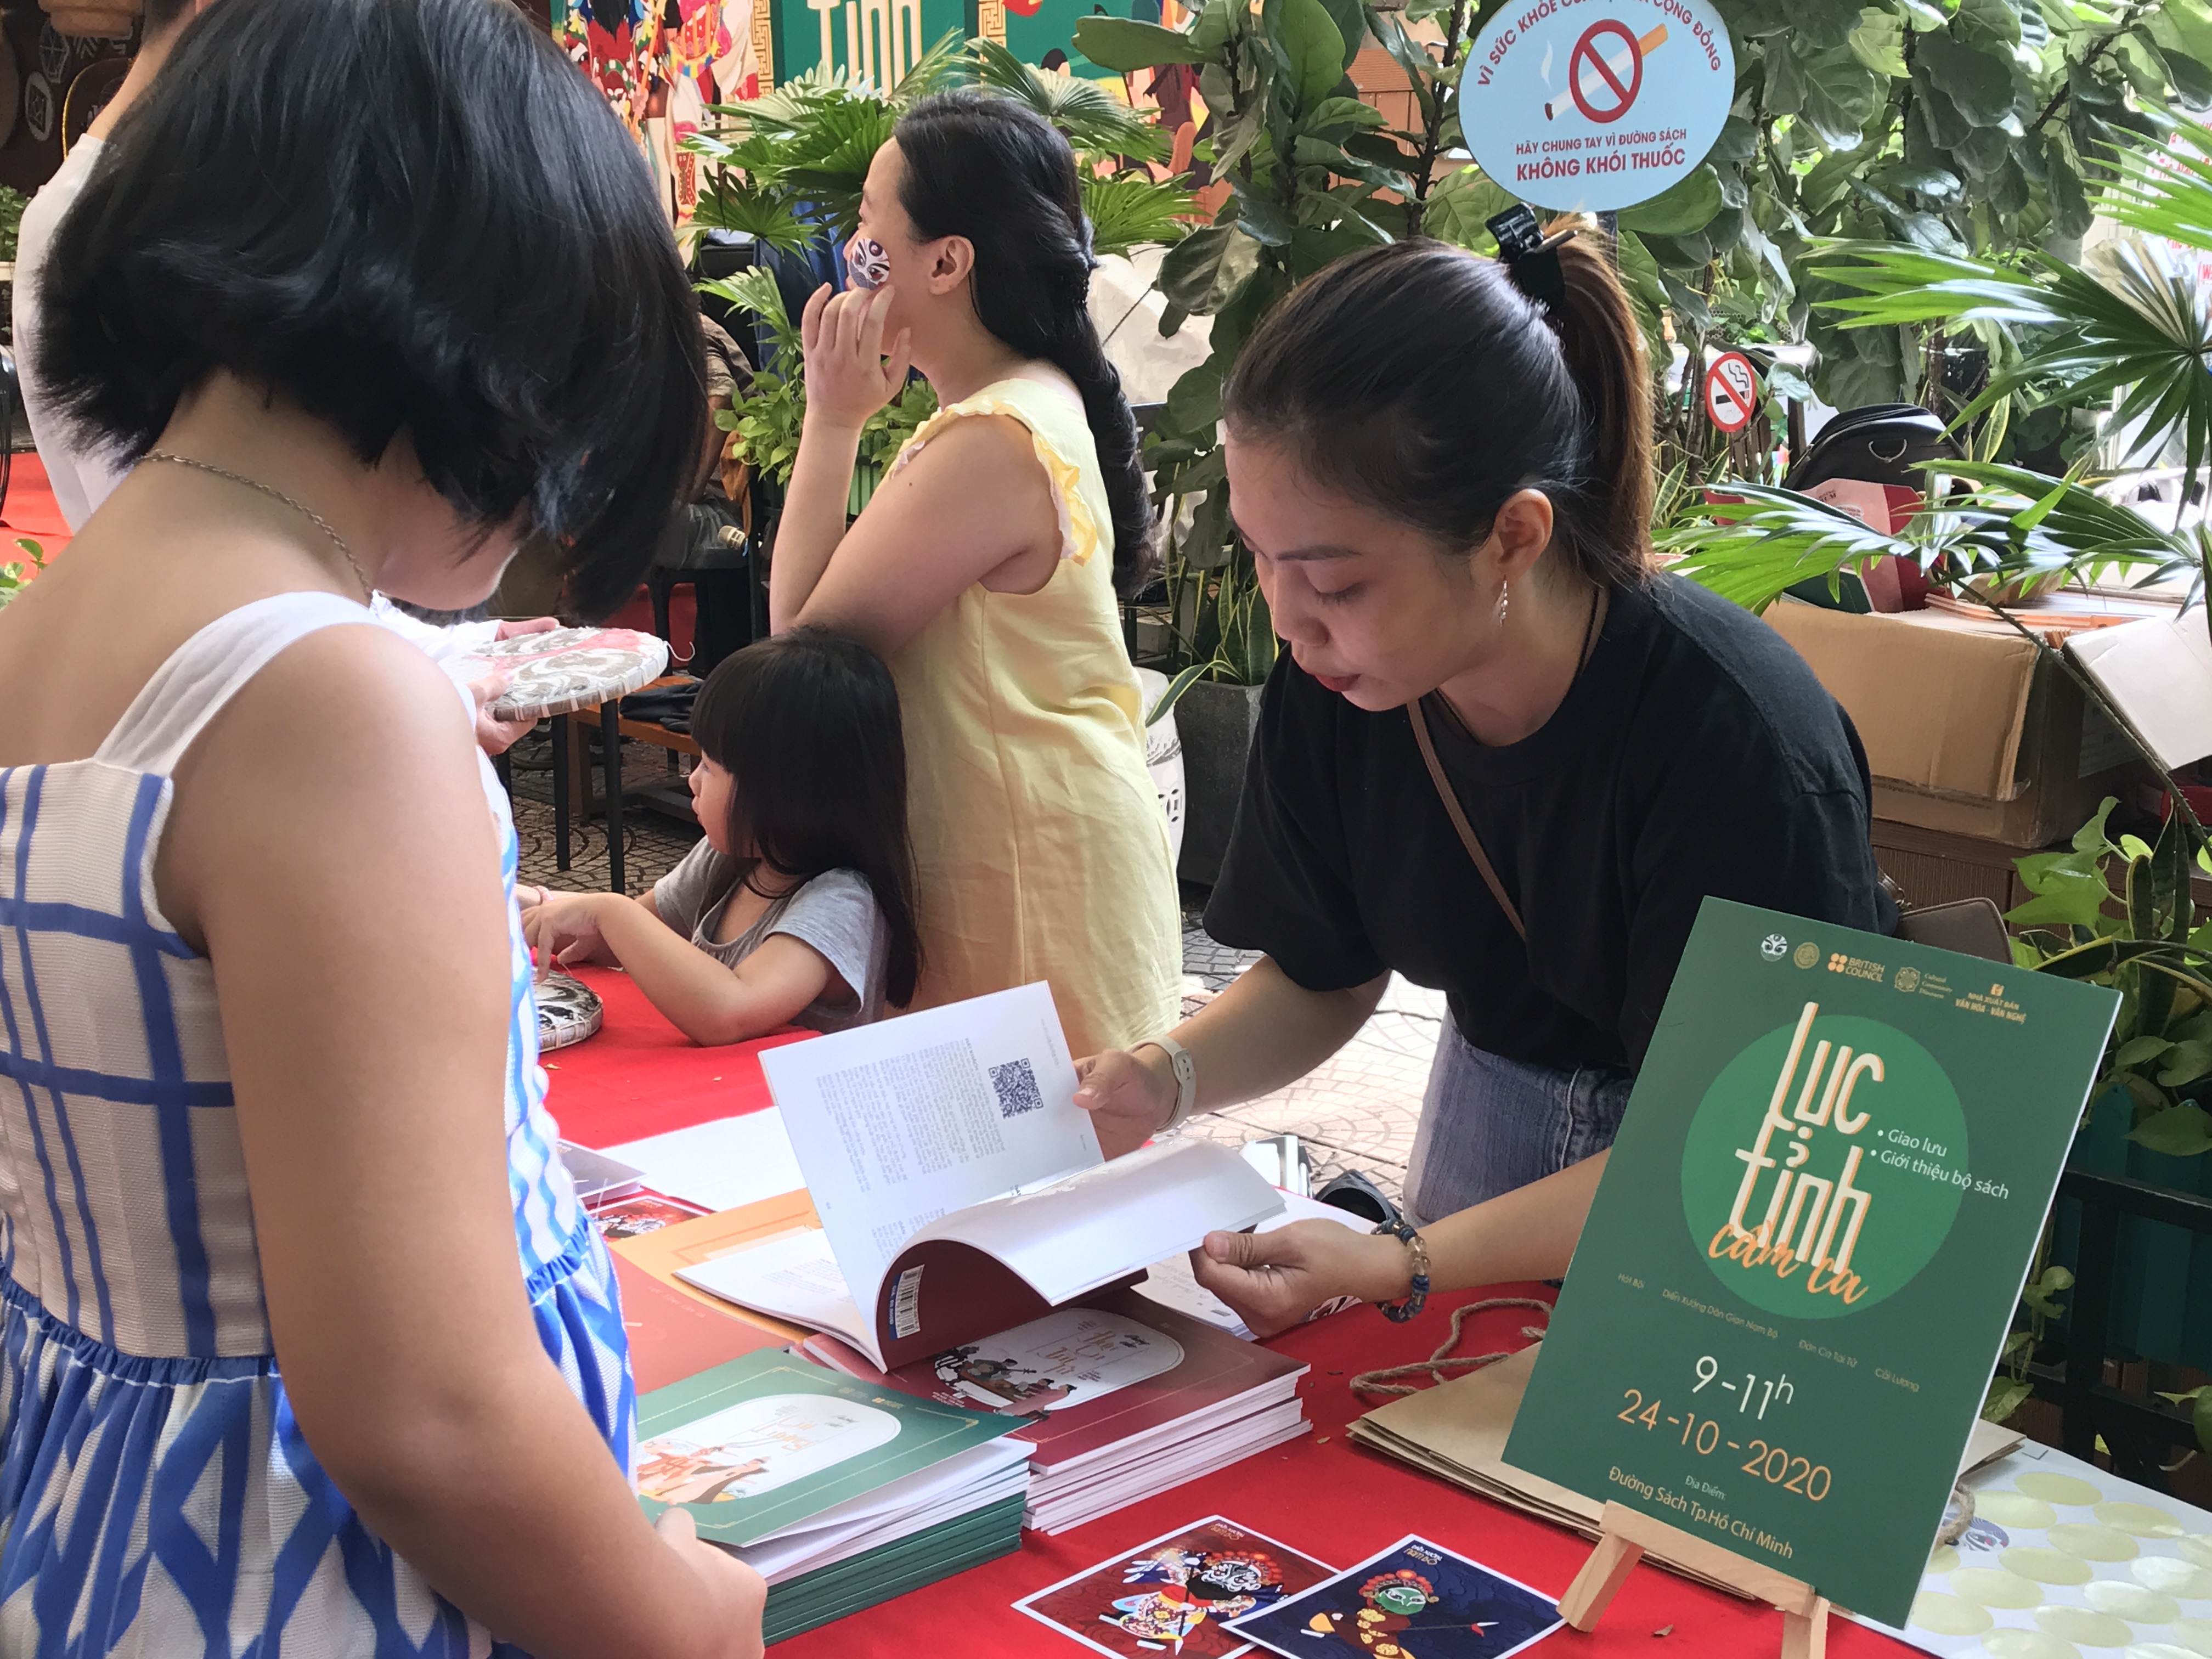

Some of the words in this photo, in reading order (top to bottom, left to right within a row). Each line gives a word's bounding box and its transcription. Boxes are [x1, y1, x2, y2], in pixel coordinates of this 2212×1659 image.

[1477, 64, 1494, 85] VÌ
[1489, 29, 1516, 65] SỨC
[1692, 20, 1721, 71] ĐỒNG
[1516, 140, 1539, 155] HÃY
[1542, 139, 1582, 153] CHUNG
[1584, 136, 1602, 149] TAY
[1605, 132, 1616, 146] VÌ
[1618, 130, 1657, 145] ĐƯỜNG
[1659, 127, 1687, 142] SÁCH
[1517, 156, 1581, 182] KHÔNG
[1585, 149, 1627, 174] KHÓI
[1631, 142, 1686, 170] THUỐC
[1845, 966, 1883, 983] COUNCIL
[1848, 957, 1886, 973] BRITISH
[1888, 1128, 1920, 1149] Giao
[1922, 1137, 1948, 1157] lưu
[1880, 1149, 1912, 1170] Giới
[1912, 1159, 1949, 1181] thiệu
[1951, 1169, 1972, 1190] bộ
[1974, 1179, 2010, 1200] sách
[1609, 1465, 1655, 1500] Đường
[1655, 1487, 1689, 1513] Sách
[1730, 1520, 1757, 1541] Chí
[1756, 1530, 1793, 1559] Minh
